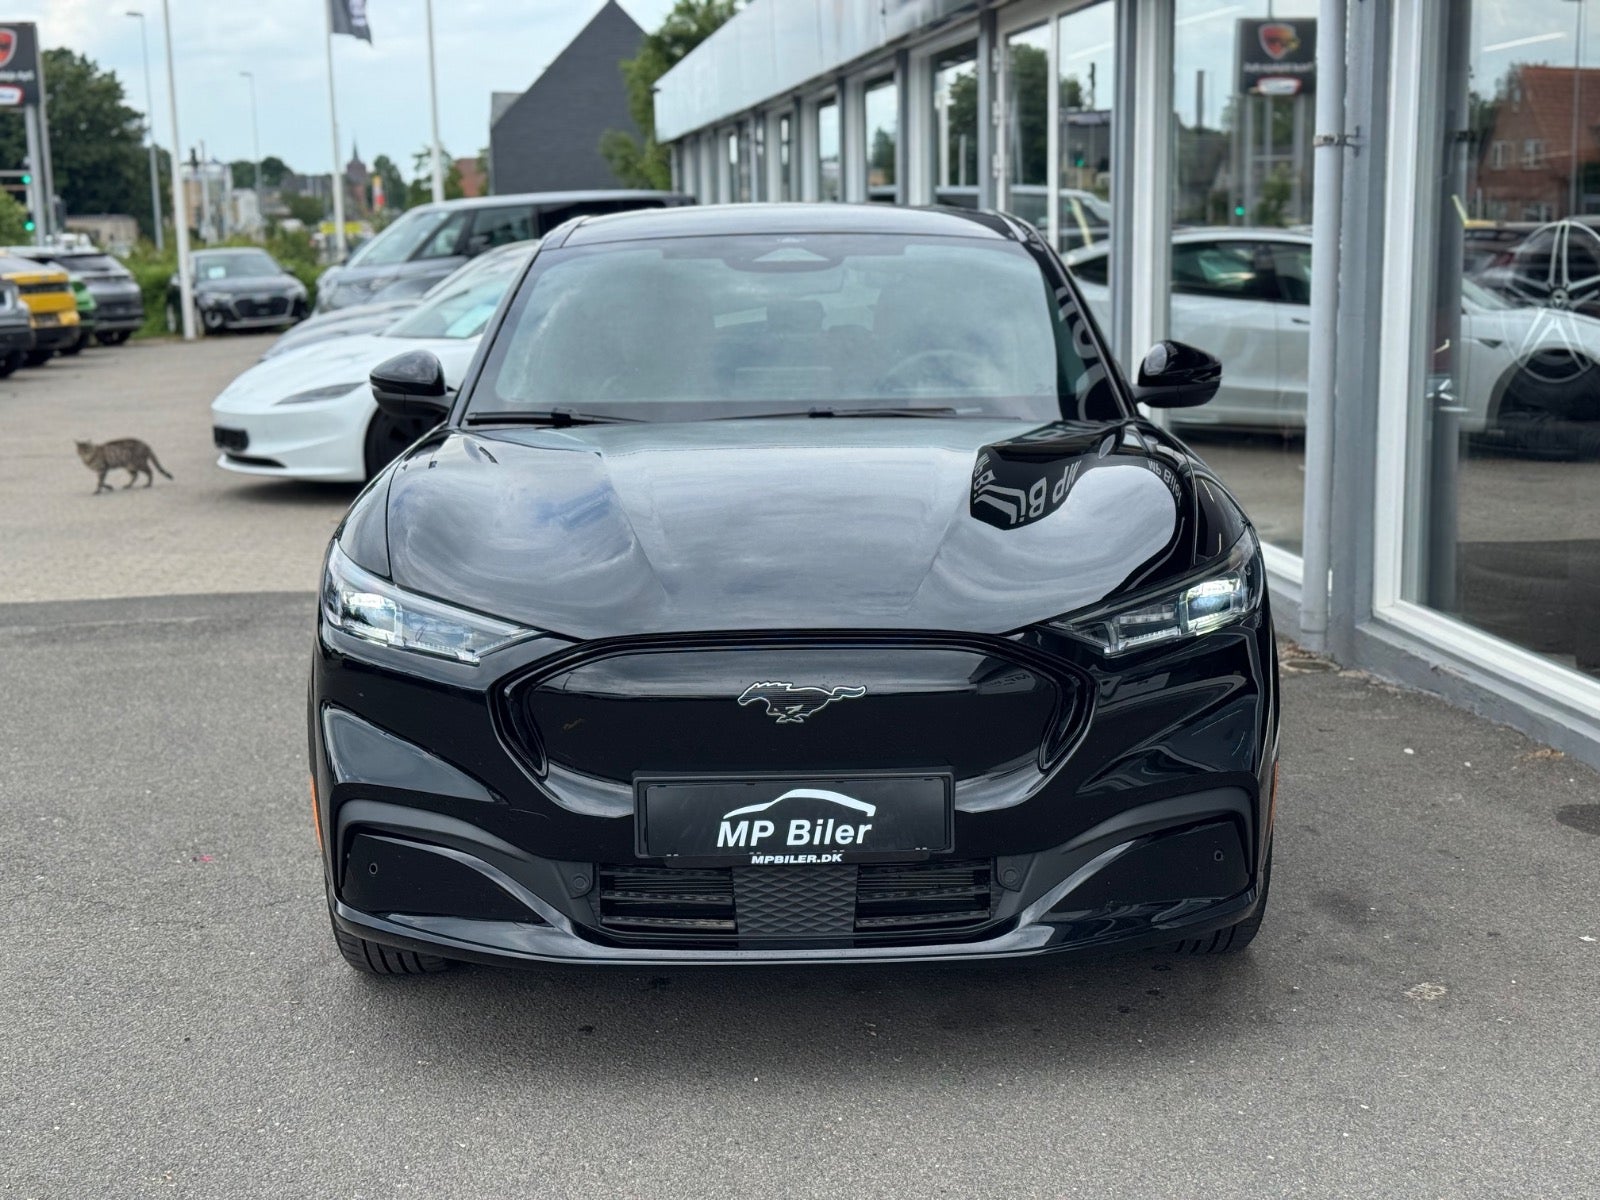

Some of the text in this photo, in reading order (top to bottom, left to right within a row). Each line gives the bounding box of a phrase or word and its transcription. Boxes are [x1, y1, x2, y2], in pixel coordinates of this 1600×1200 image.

[716, 818, 873, 848] MP Biler
[751, 853, 843, 865] MPBILER.DK
